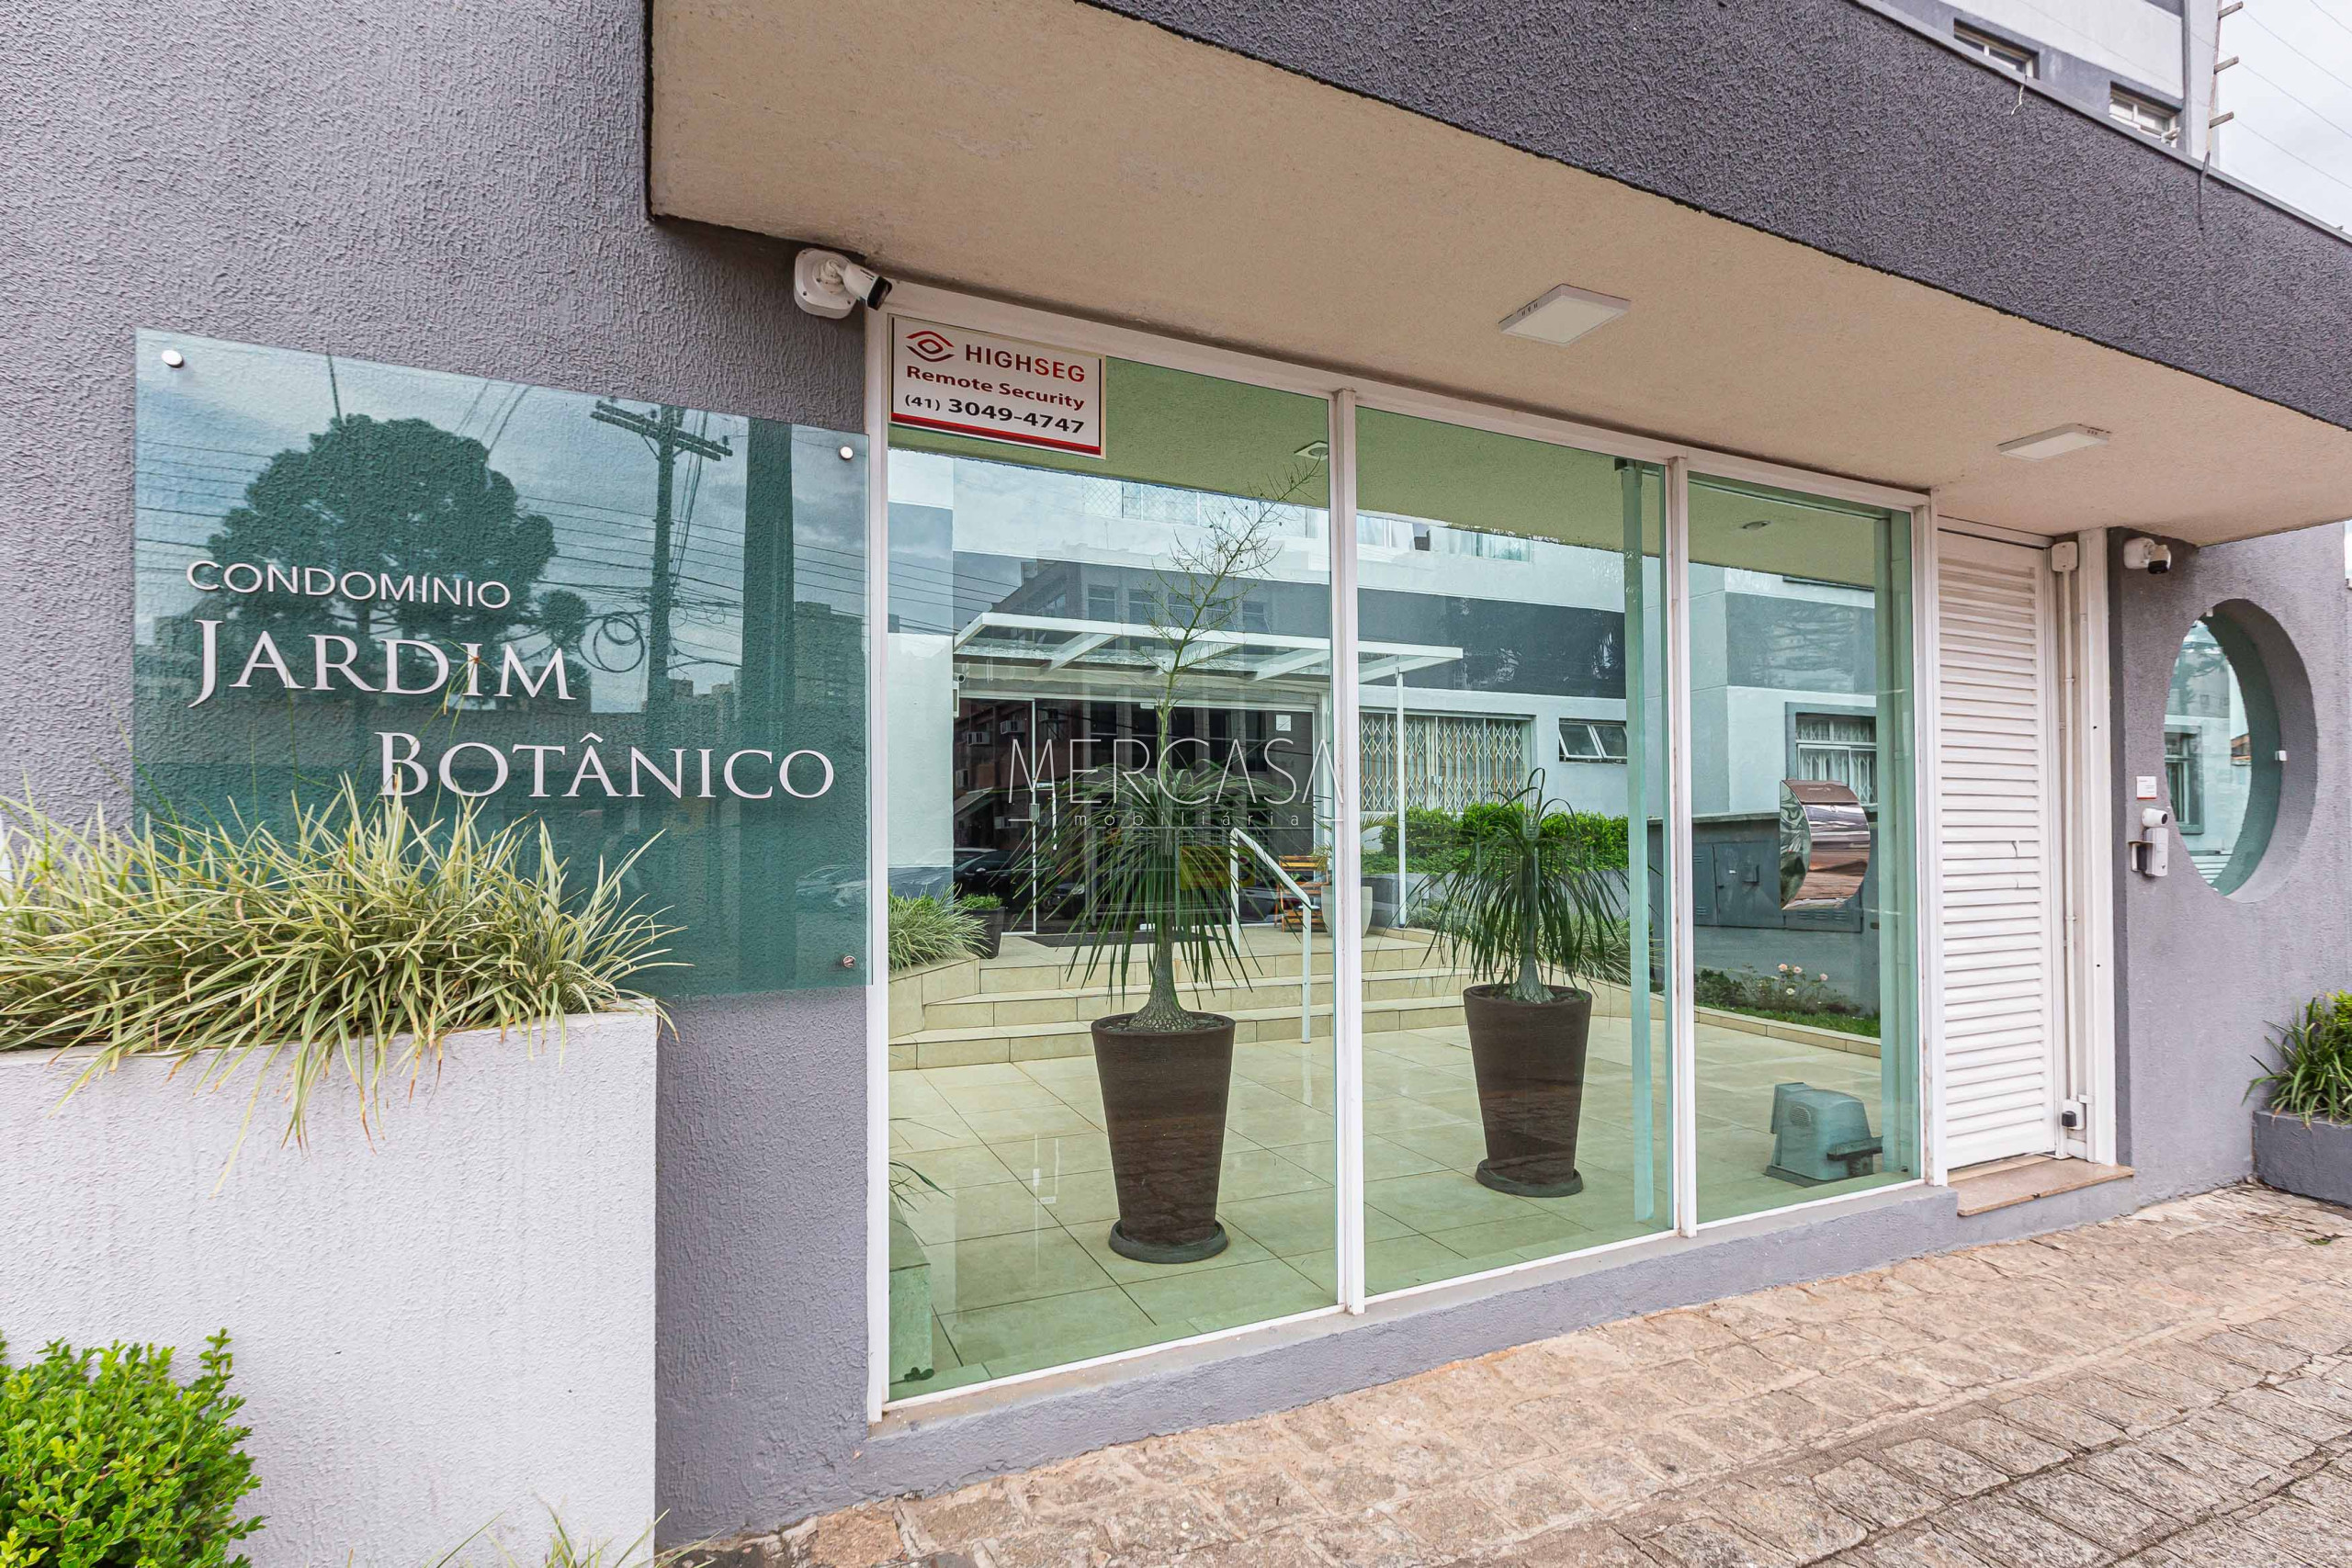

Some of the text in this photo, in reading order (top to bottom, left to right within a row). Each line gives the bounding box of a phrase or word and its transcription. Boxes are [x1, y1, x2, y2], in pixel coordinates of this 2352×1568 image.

[966, 344, 1085, 383] HIGHSEG
[906, 365, 1085, 411] Remote Security
[905, 394, 1085, 434] (41) 3049-4747
[186, 560, 511, 609] CONDOMINIO
[187, 619, 577, 709] JARDIM
[375, 731, 835, 799] BOTÂNICO
